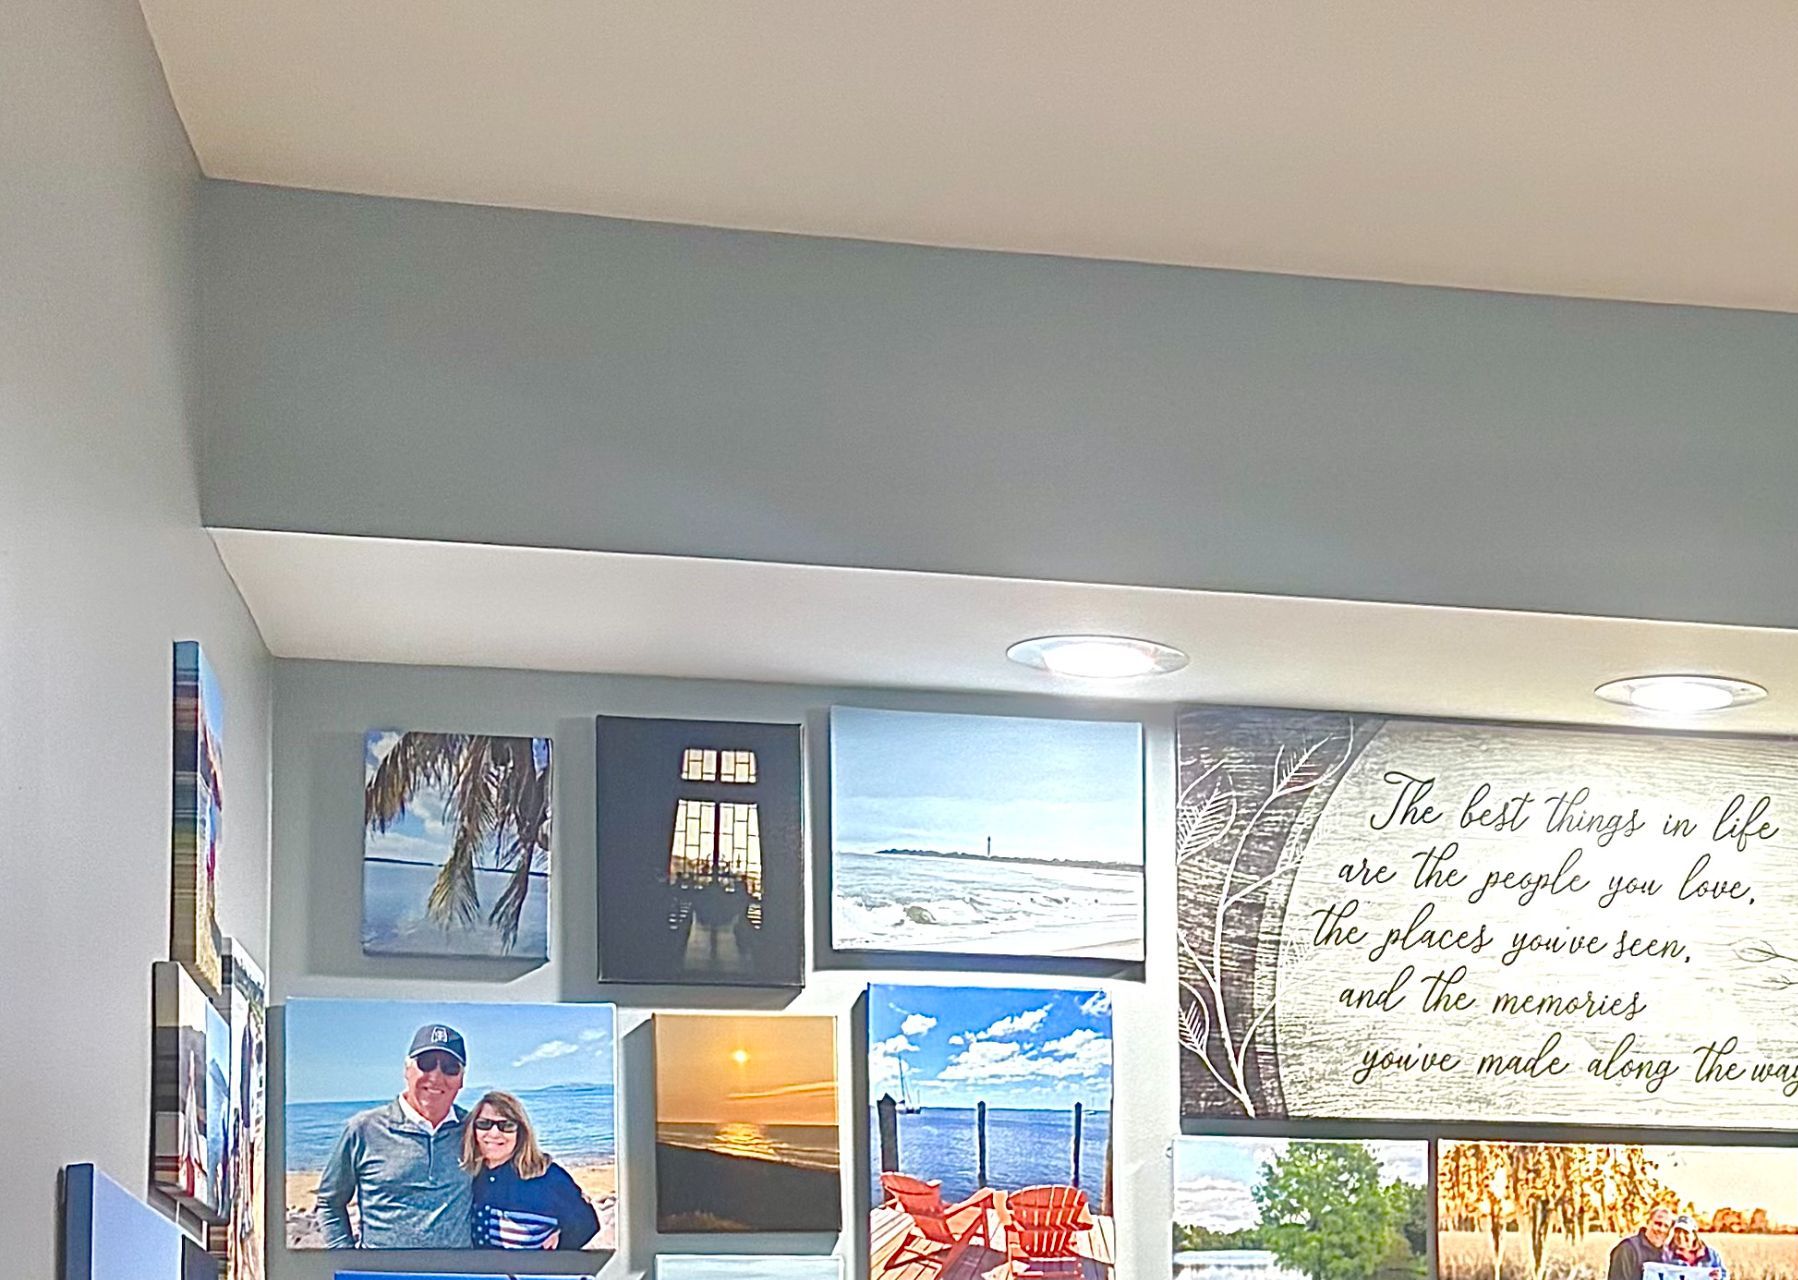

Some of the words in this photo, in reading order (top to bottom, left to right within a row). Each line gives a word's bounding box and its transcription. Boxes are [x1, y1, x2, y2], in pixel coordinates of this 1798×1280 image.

[1370, 771, 1443, 830] The
[1460, 783, 1535, 832] best
[1544, 787, 1646, 848] things
[1662, 814, 1698, 838] in
[1712, 794, 1780, 852] life
[1338, 858, 1397, 885] are
[1412, 842, 1468, 889] the
[1468, 848, 1590, 906] people
[1598, 875, 1663, 909] you
[1678, 853, 1755, 905] love,
[1311, 899, 1369, 947] the
[1368, 902, 1494, 962] places
[1501, 926, 1608, 966] you've
[1612, 930, 1691, 963] seen,
[1338, 965, 1415, 1012] and
[1420, 965, 1476, 1013] the
[1491, 991, 1647, 1021] memories
[1352, 1043, 1461, 1085] you've
[1476, 1031, 1570, 1078] made
[1587, 1032, 1680, 1093] along
[1693, 1036, 1746, 1083] the
